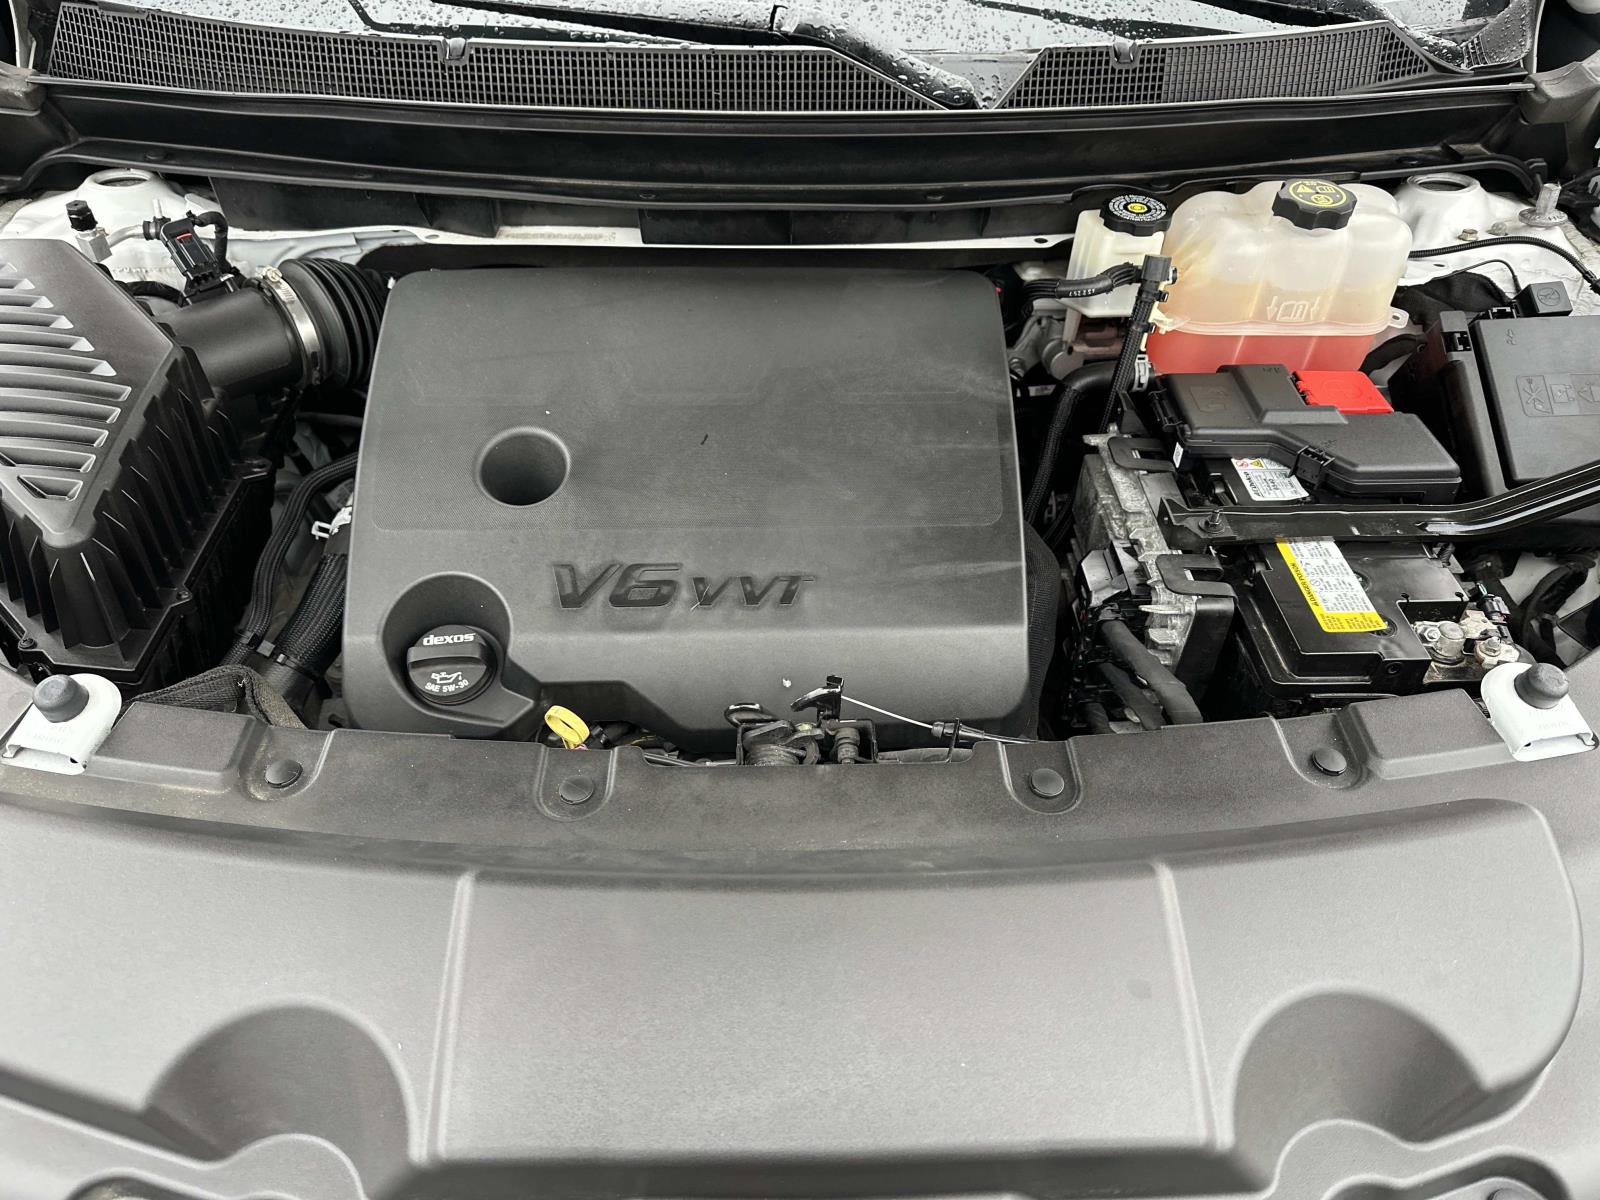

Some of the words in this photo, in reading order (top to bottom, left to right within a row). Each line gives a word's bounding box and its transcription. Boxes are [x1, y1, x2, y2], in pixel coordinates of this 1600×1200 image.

[553, 563, 684, 609] V6
[692, 576, 816, 606] VVT
[422, 632, 477, 646] dexos
[424, 681, 441, 693] SAE
[442, 679, 470, 693] 5W-30
